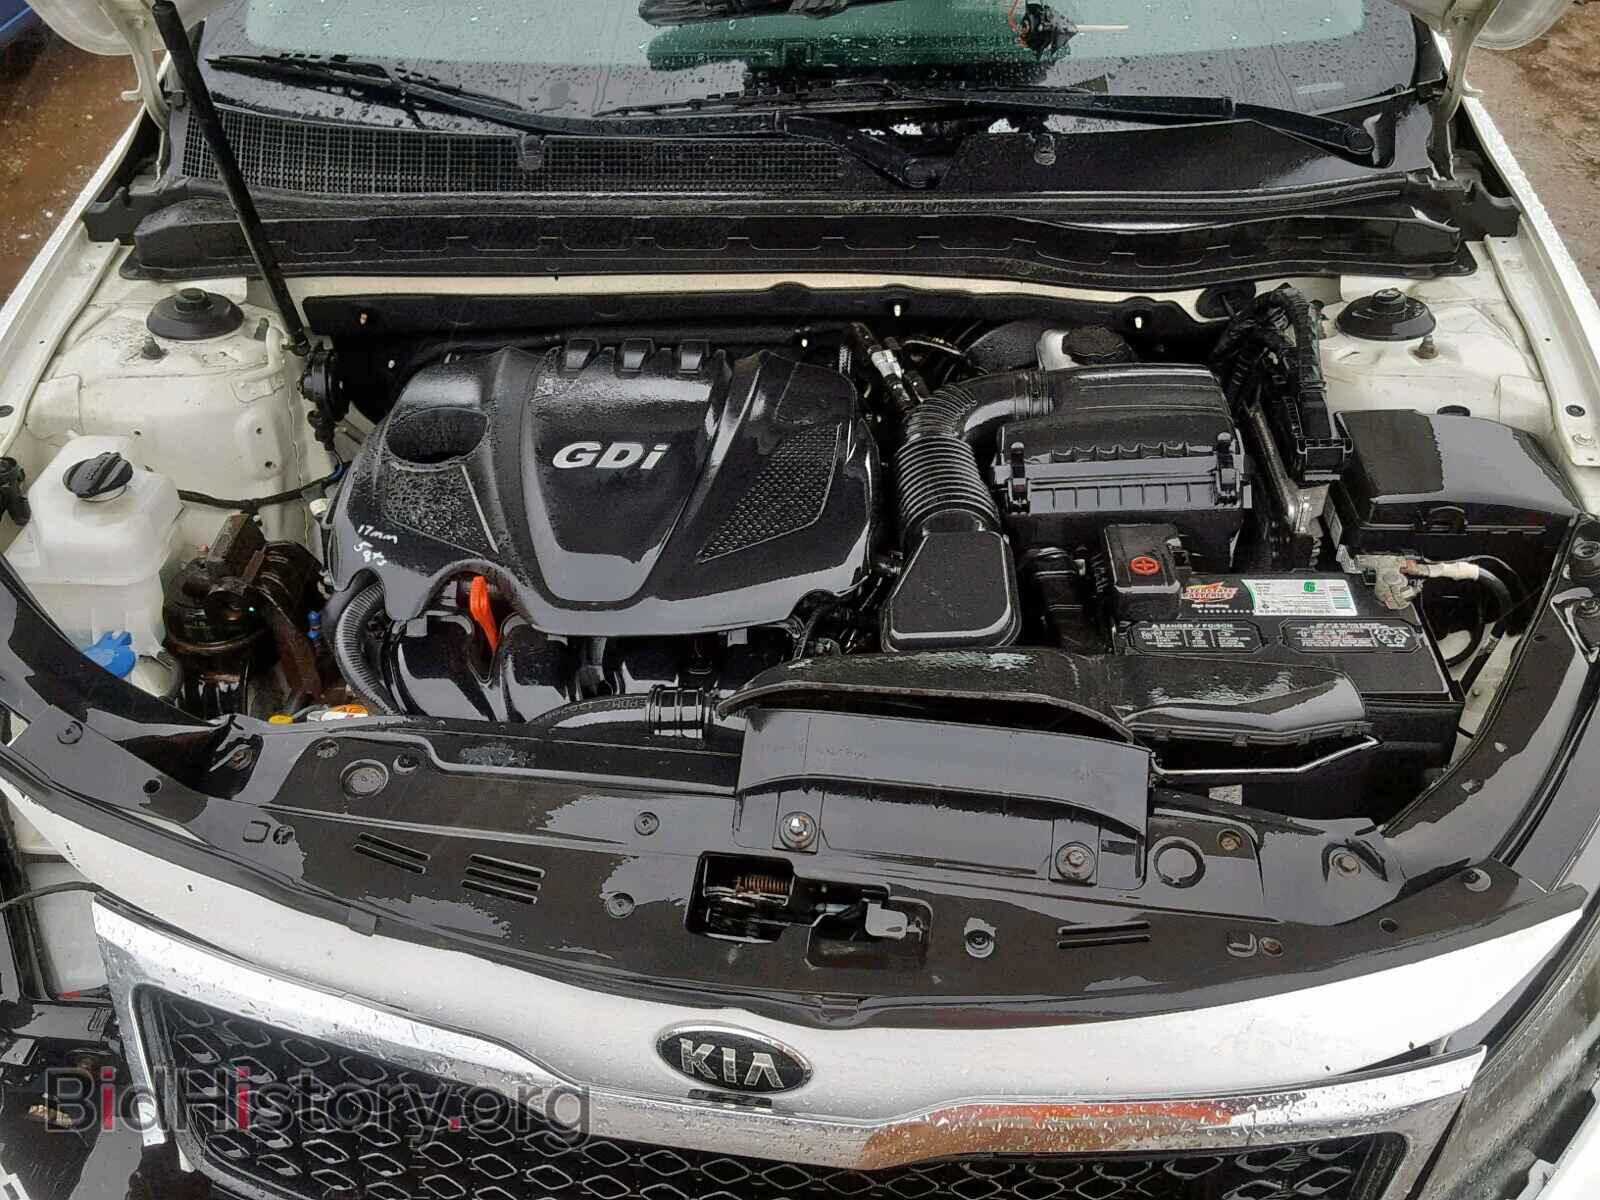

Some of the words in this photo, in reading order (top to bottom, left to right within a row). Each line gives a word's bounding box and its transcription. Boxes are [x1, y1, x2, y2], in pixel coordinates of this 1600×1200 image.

[552, 441, 671, 470] GDi
[357, 524, 398, 545] 17mm
[679, 1037, 784, 1089] KIA
